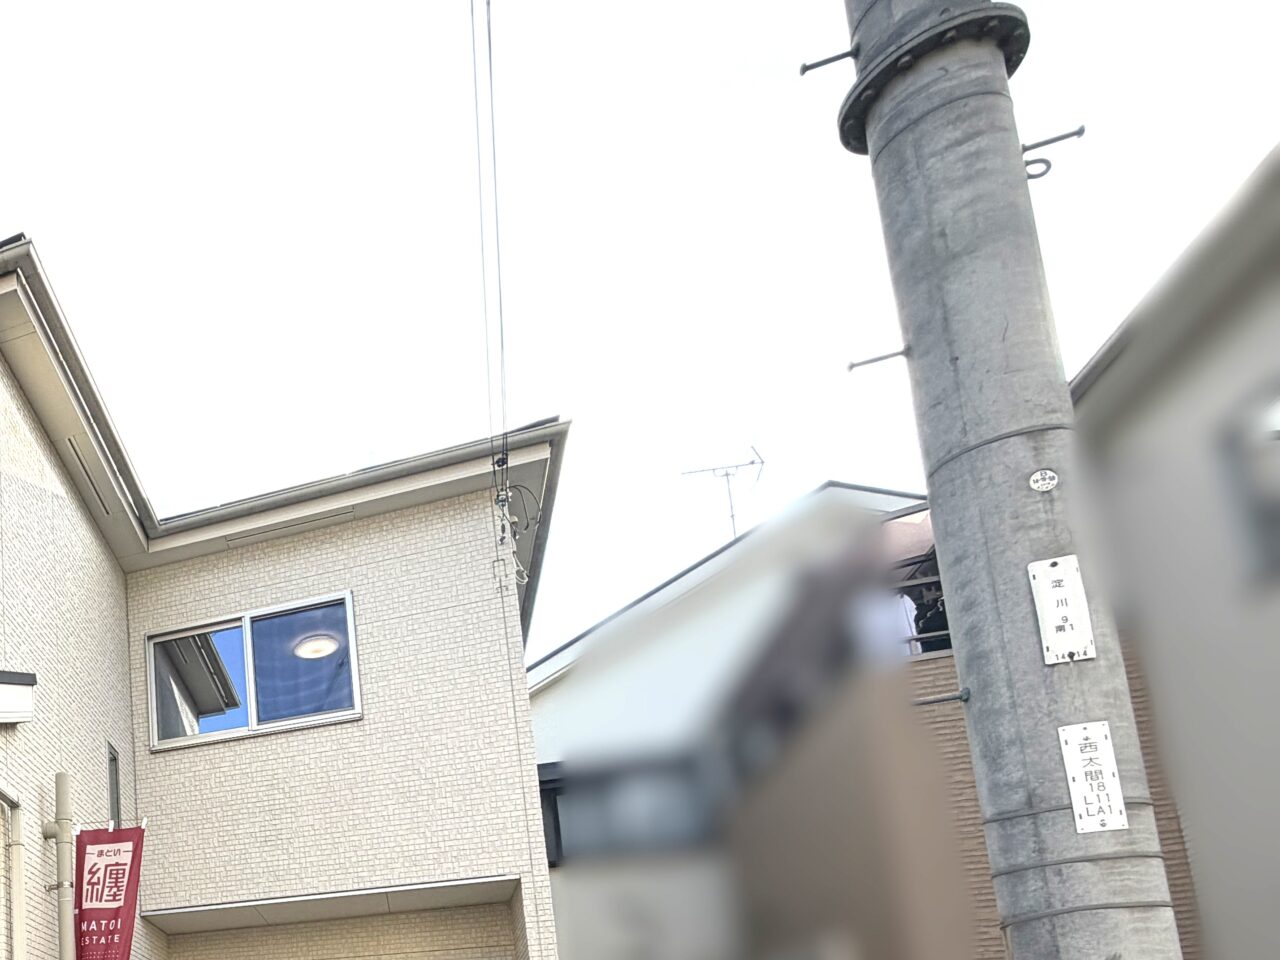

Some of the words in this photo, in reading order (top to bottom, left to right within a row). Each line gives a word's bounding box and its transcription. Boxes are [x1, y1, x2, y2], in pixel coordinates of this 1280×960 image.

[1061, 615, 1068, 624] 9
[1089, 781, 1106, 793] 18
[1086, 805, 1113, 817] LA1
[96, 848, 121, 858] まとい
